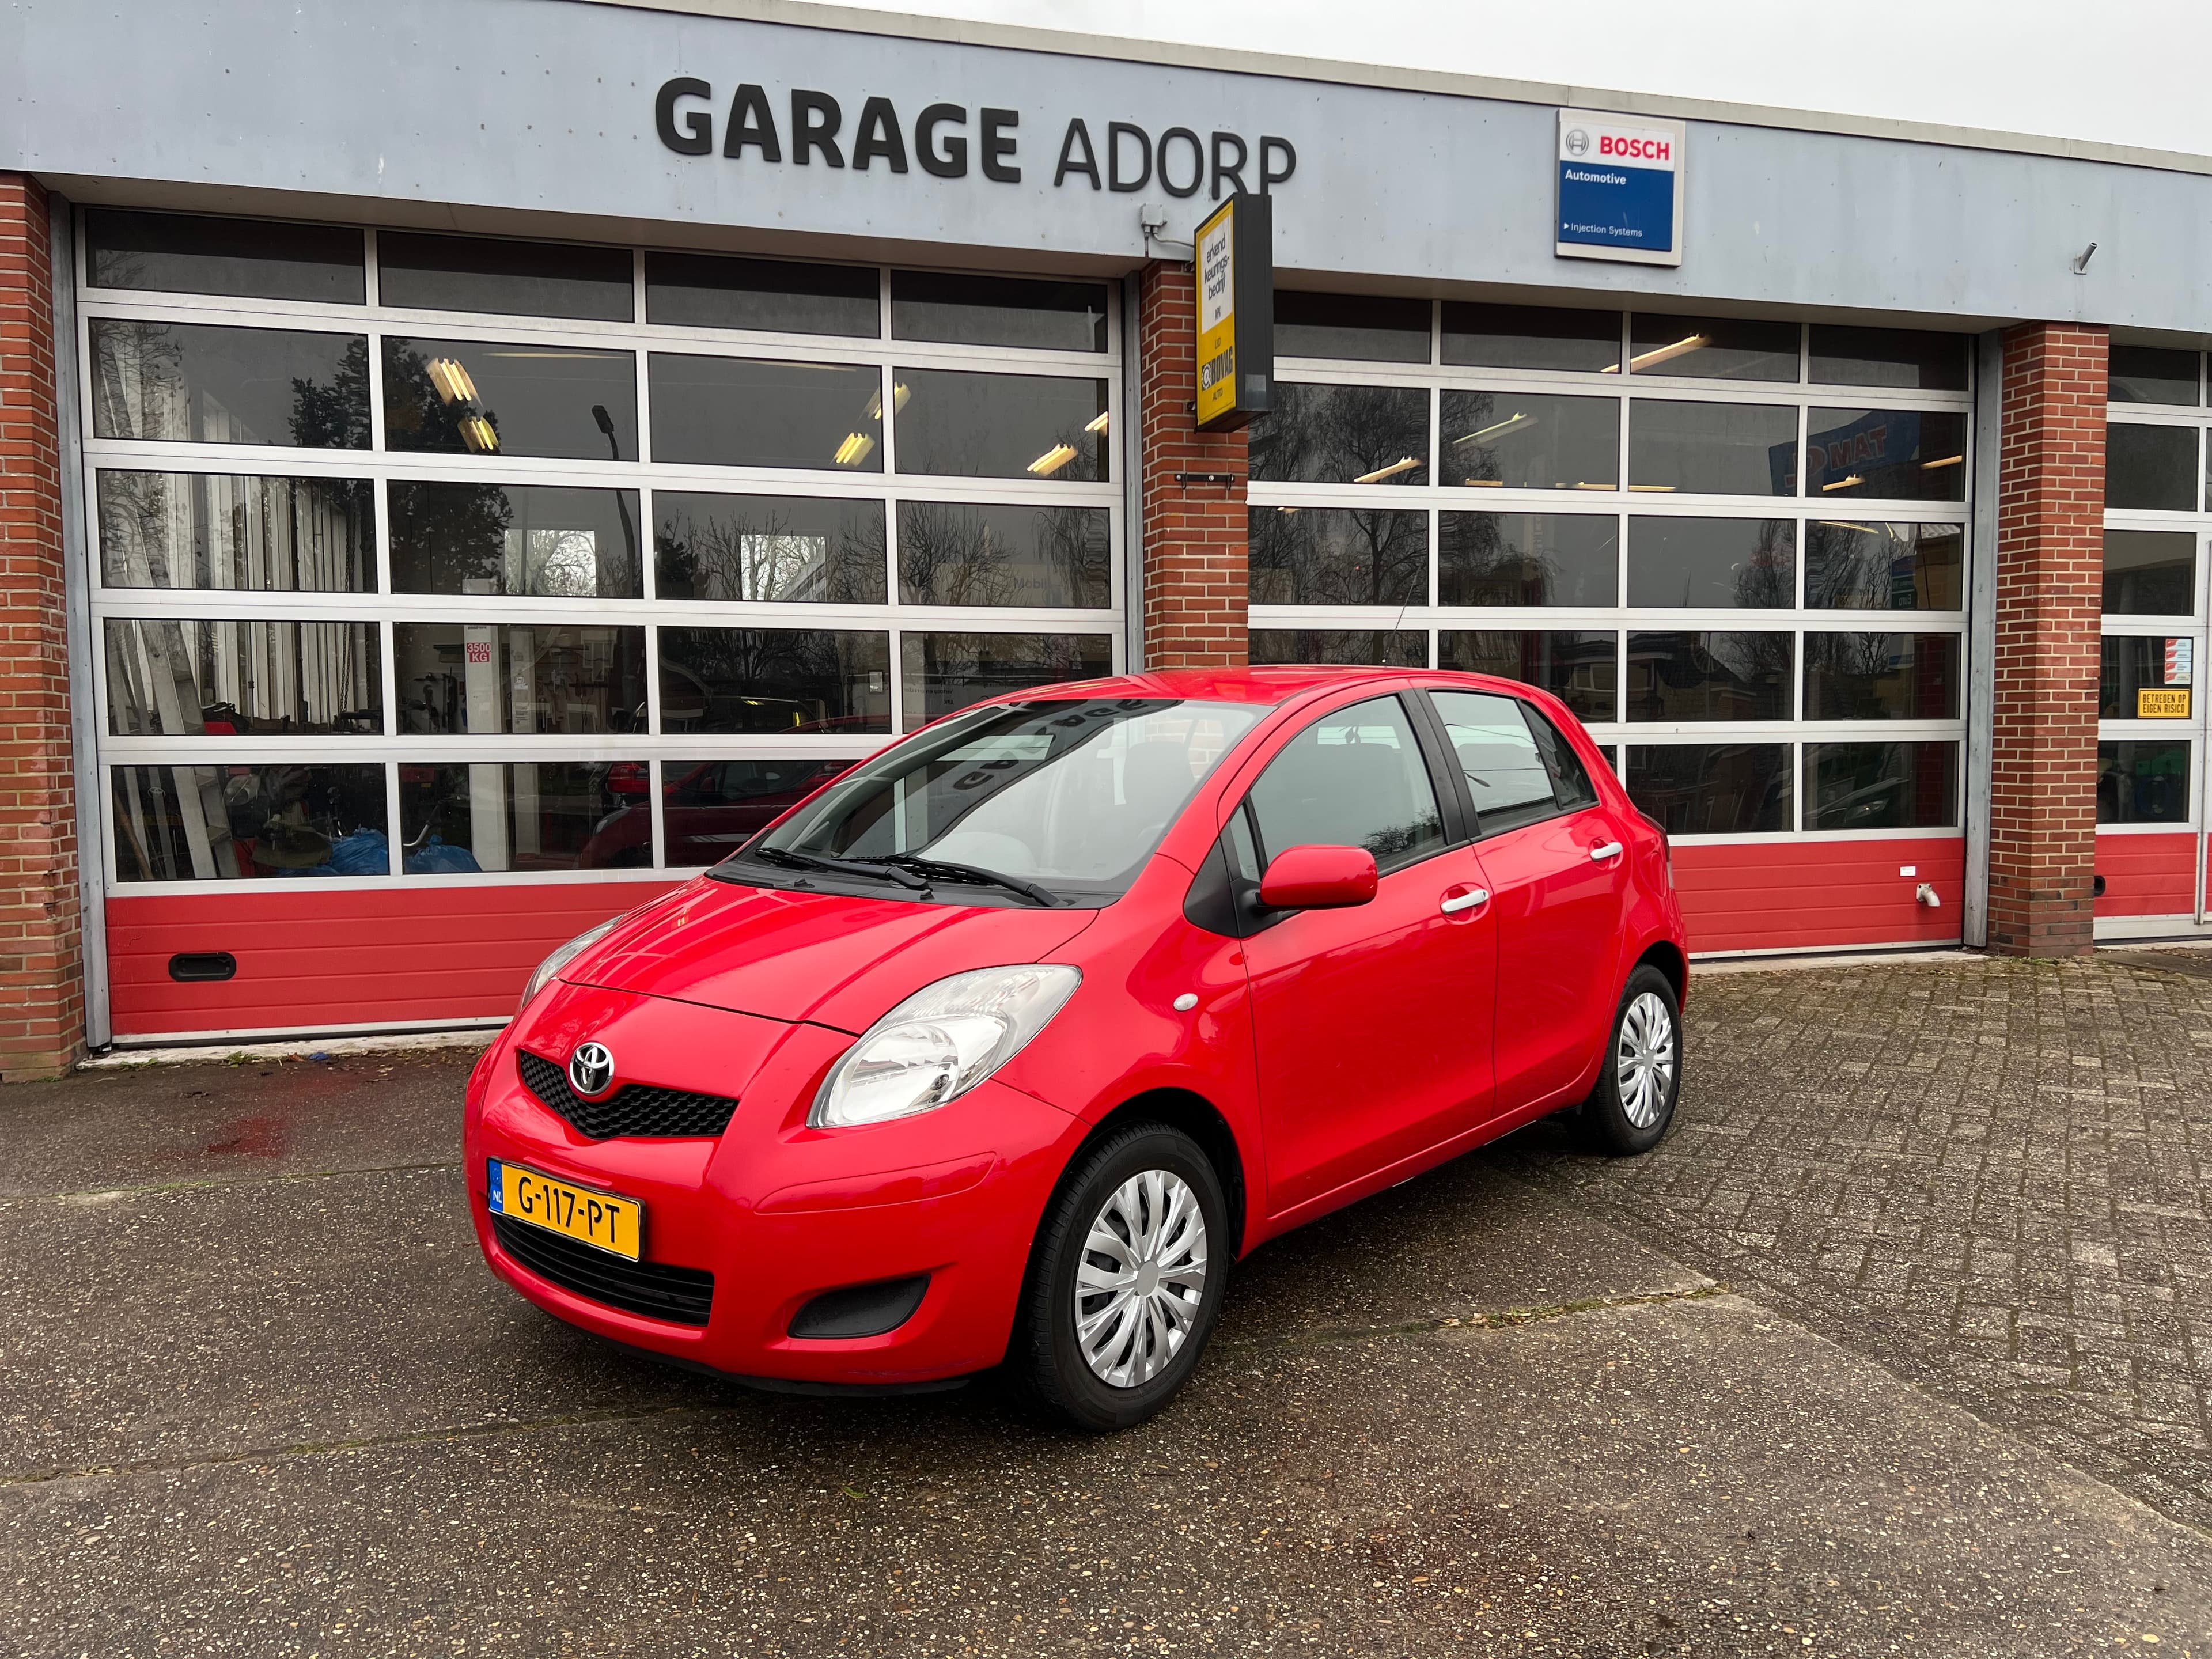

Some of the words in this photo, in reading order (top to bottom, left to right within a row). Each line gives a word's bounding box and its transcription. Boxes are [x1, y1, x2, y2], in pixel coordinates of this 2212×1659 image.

[655, 77, 1021, 183] GARAGE
[1054, 118, 1296, 200] ADORP
[1600, 135, 1669, 160] BOSCH
[1565, 169, 1627, 185] Automotive
[1571, 222, 1607, 233] Injection
[1609, 225, 1642, 237] Systems
[1206, 233, 1226, 263] erkend
[1204, 255, 1230, 285] keurings-
[1208, 272, 1226, 301] bedrijf
[1211, 346, 1233, 385] BOVAG
[467, 642, 491, 653] 3500
[472, 653, 488, 662] KG
[2142, 694, 2176, 703] BETREDEN
[2178, 694, 2186, 703] OP
[2142, 704, 2161, 713] EIGEN
[2164, 704, 2185, 713] RISICO
[493, 1190, 502, 1203] NL
[518, 1176, 620, 1243] G-117-PT
